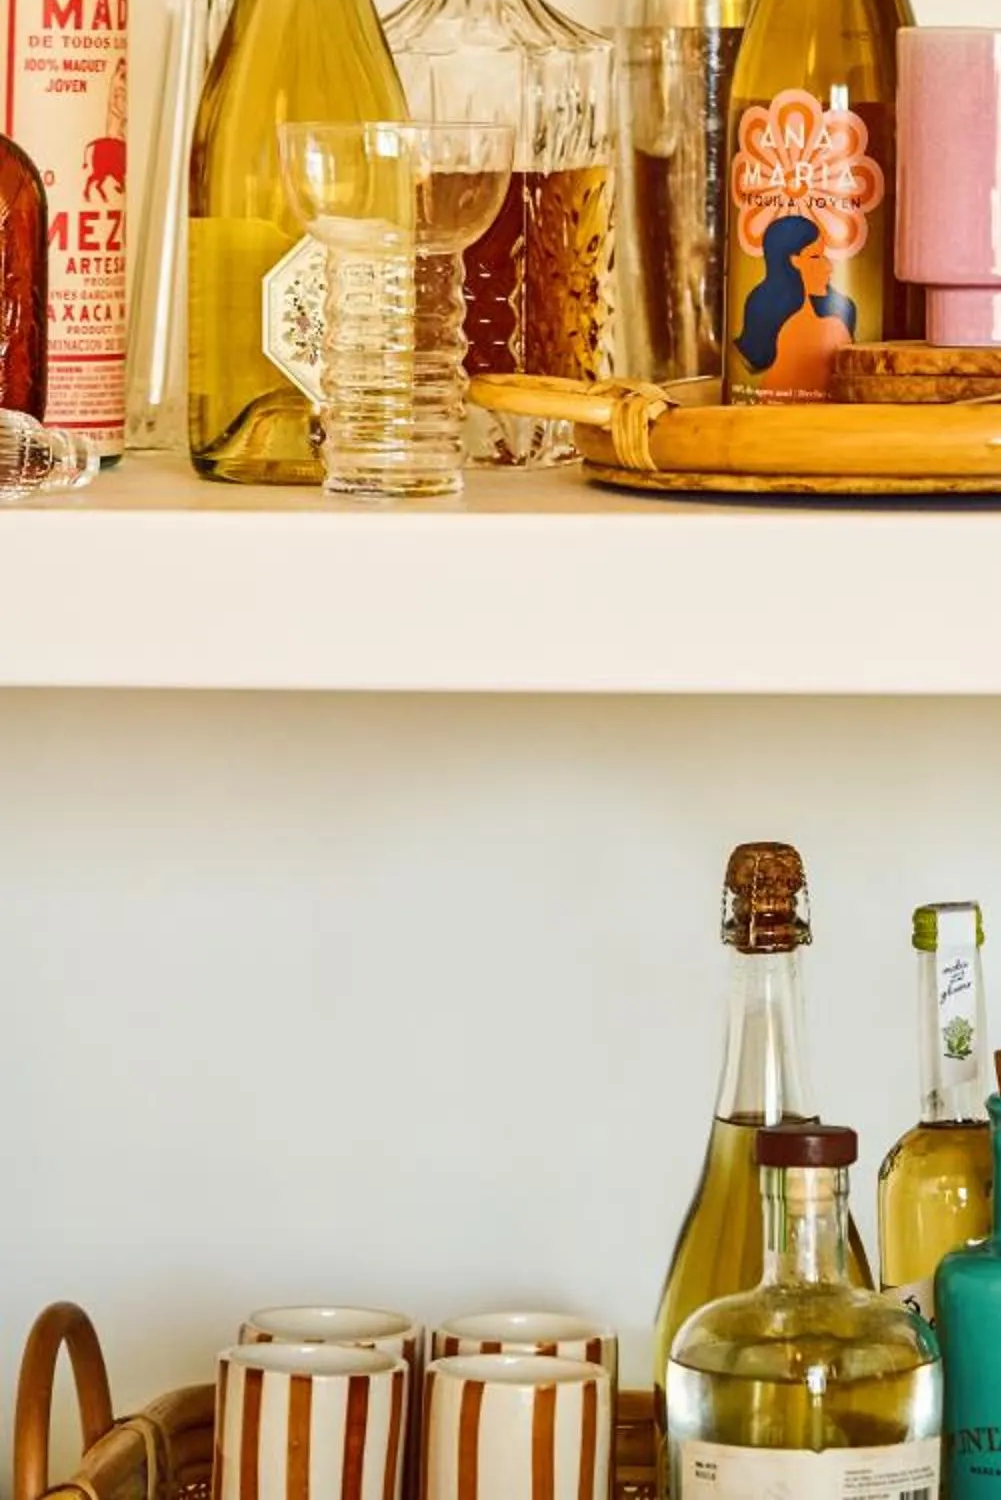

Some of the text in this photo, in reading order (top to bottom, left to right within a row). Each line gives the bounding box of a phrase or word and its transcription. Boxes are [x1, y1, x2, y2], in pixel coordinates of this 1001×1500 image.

[28, 35, 53, 48] DE
[62, 35, 110, 48] TODOS
[45, 79, 87, 92] JOVEN
[760, 124, 833, 149] ANA
[743, 161, 859, 188] MARIA
[741, 193, 861, 209] TEQUILA JOVEN
[48, 210, 126, 250] MEZ
[47, 304, 112, 321] AXACA
